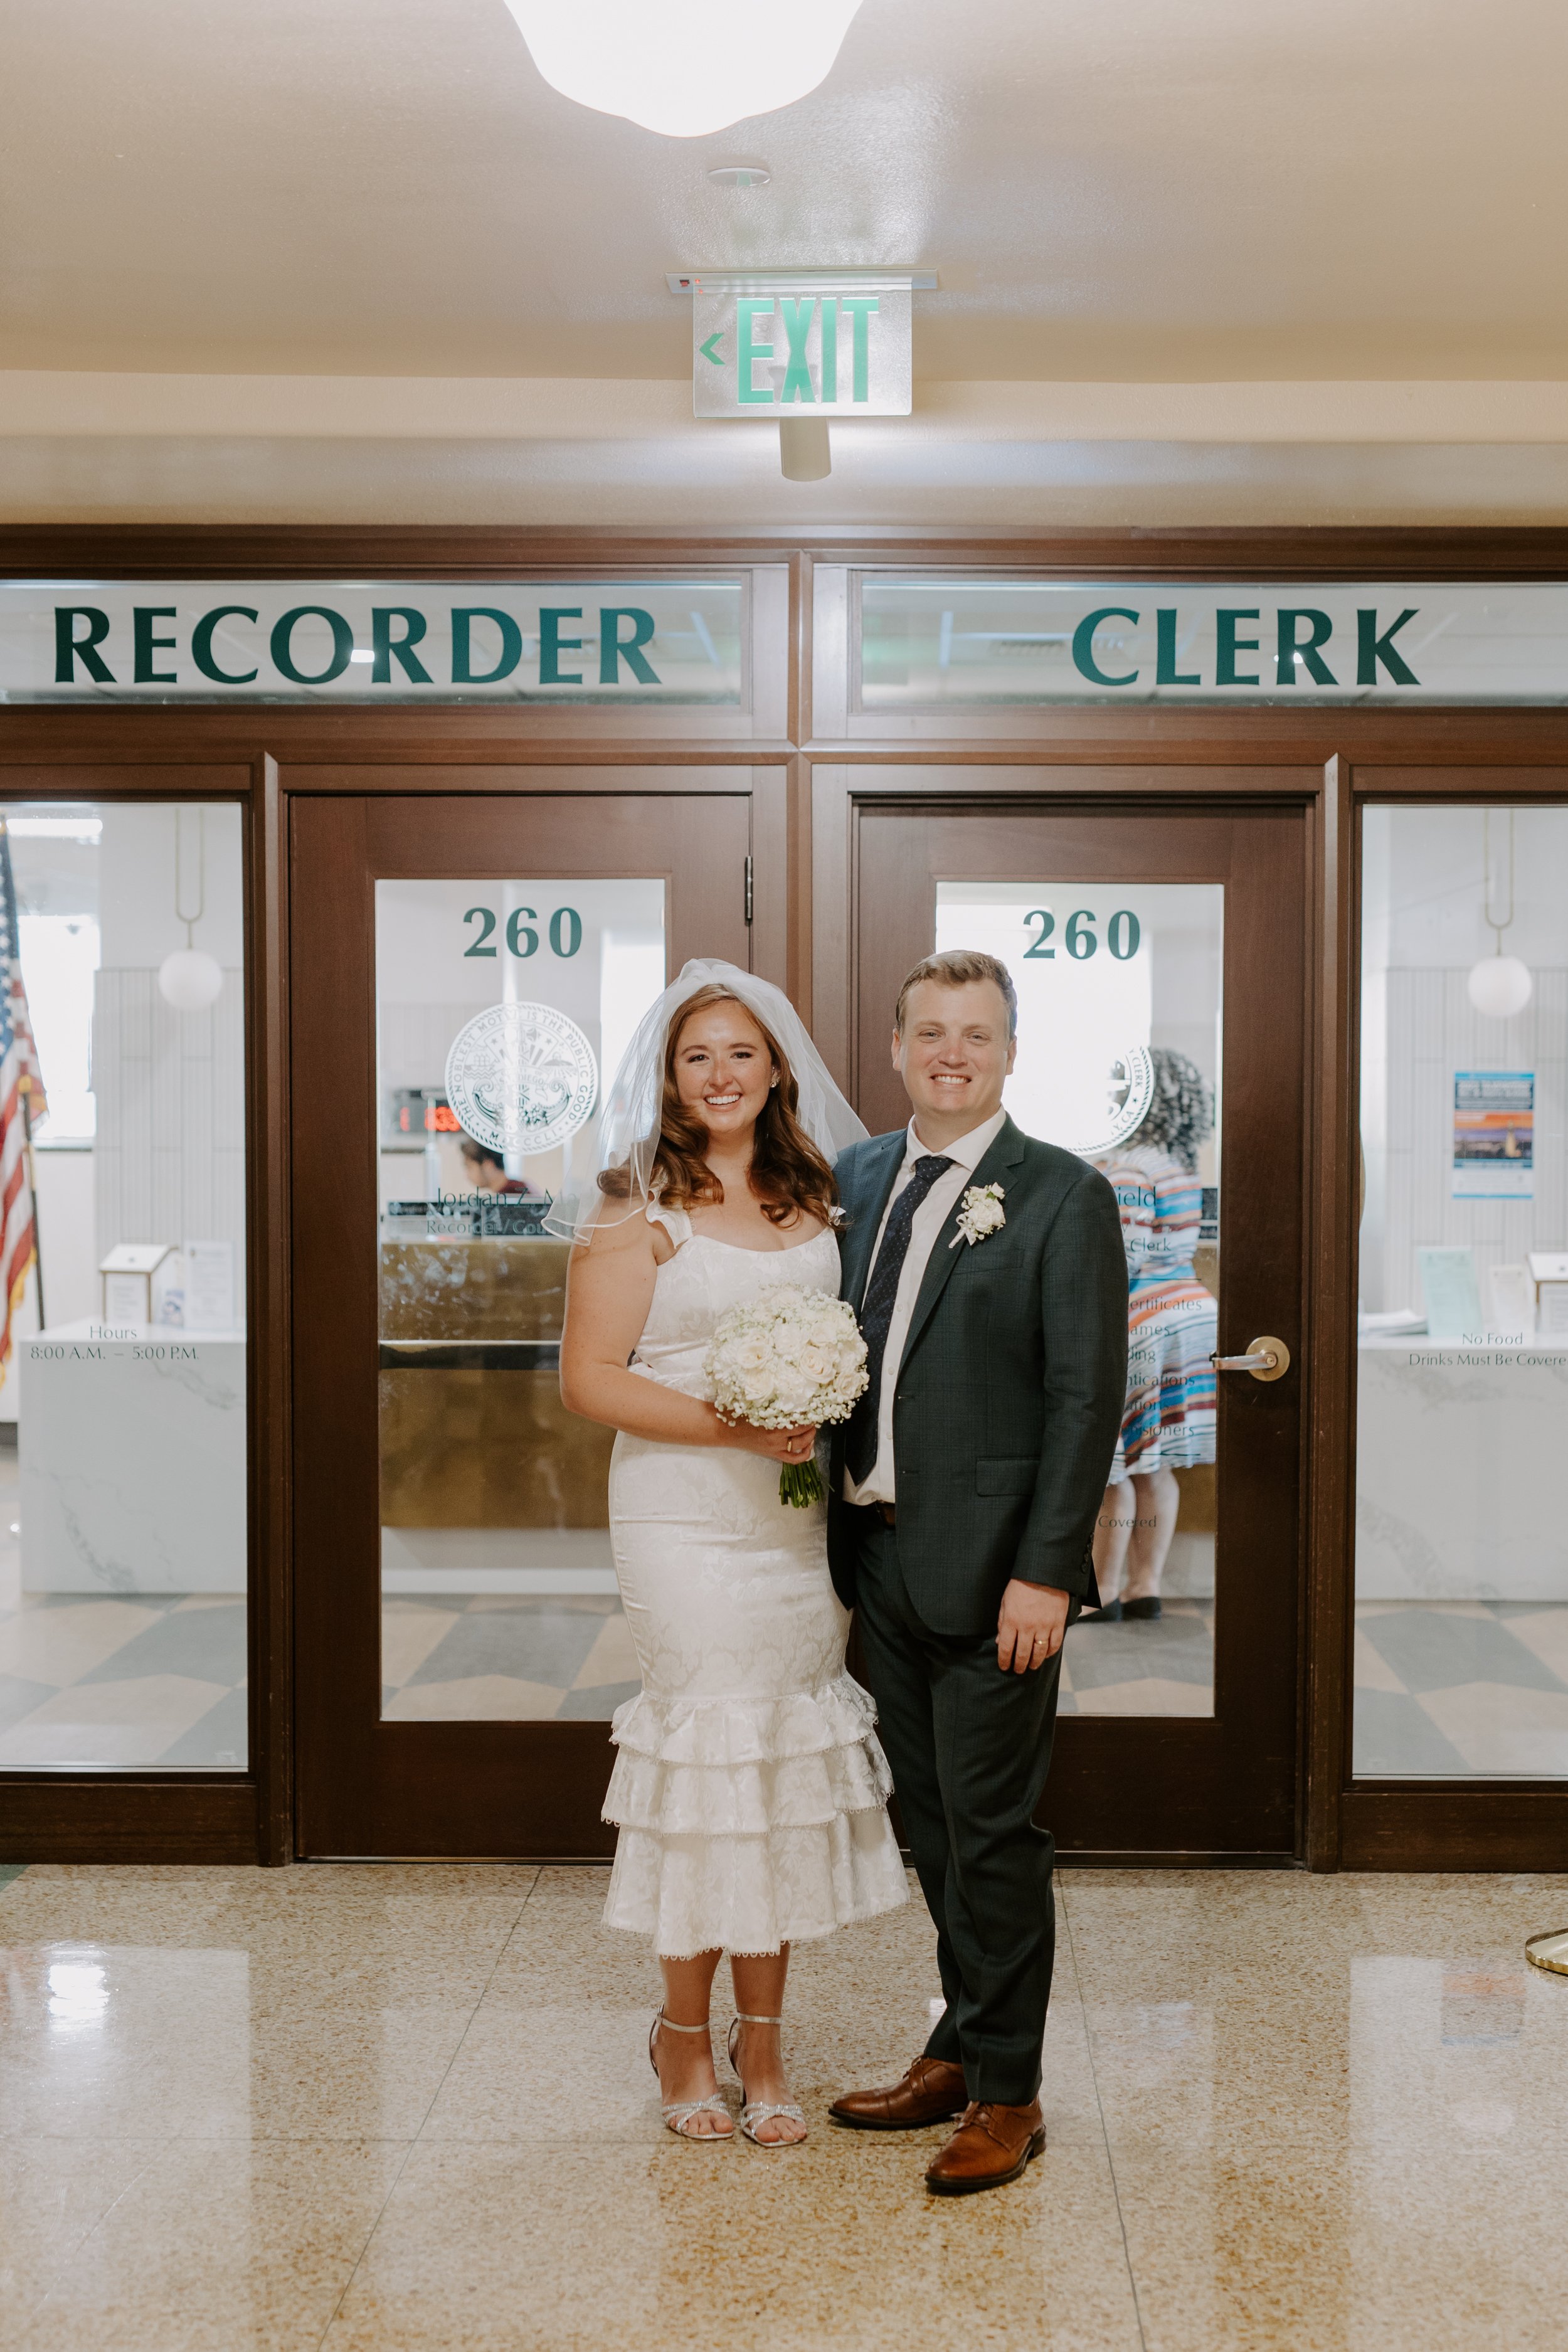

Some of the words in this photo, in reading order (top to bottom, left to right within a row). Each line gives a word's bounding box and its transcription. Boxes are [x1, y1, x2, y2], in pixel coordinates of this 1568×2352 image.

[737, 297, 879, 405] EXIT
[54, 605, 662, 684] RECORDER
[1072, 607, 1422, 686] CLERK
[463, 907, 582, 958] 260
[1023, 909, 1140, 960] 260
[527, 1010, 538, 1021] IS
[541, 1015, 564, 1033] THE
[453, 1034, 475, 1093] NOBLEST
[565, 1035, 589, 1078] PUBLIC
[1131, 1057, 1143, 1088] CLERK
[458, 1098, 475, 1121] THE
[568, 1085, 588, 1121] GOOD
[1121, 1110, 1134, 1123] CA
[438, 1186, 507, 1207] Jordan
[1115, 1185, 1156, 1207] ield
[1130, 1237, 1171, 1252] Clerk
[1130, 1296, 1202, 1311] ertificates
[90, 1325, 137, 1340] Hours
[1130, 1325, 1170, 1336] ames
[1463, 1332, 1482, 1345] No
[1488, 1332, 1523, 1345] Food
[31, 1346, 64, 1360] 8:00
[69, 1346, 106, 1360] A.M.
[132, 1346, 164, 1360] 5:00
[171, 1346, 199, 1360] P.M.
[1409, 1352, 1453, 1366] Drinks
[1457, 1353, 1490, 1366] Must
[1495, 1353, 1513, 1366] Be
[1517, 1353, 1568, 1366] Covere
[1128, 1372, 1195, 1386] ntications
[1098, 1515, 1157, 1528] Covered
